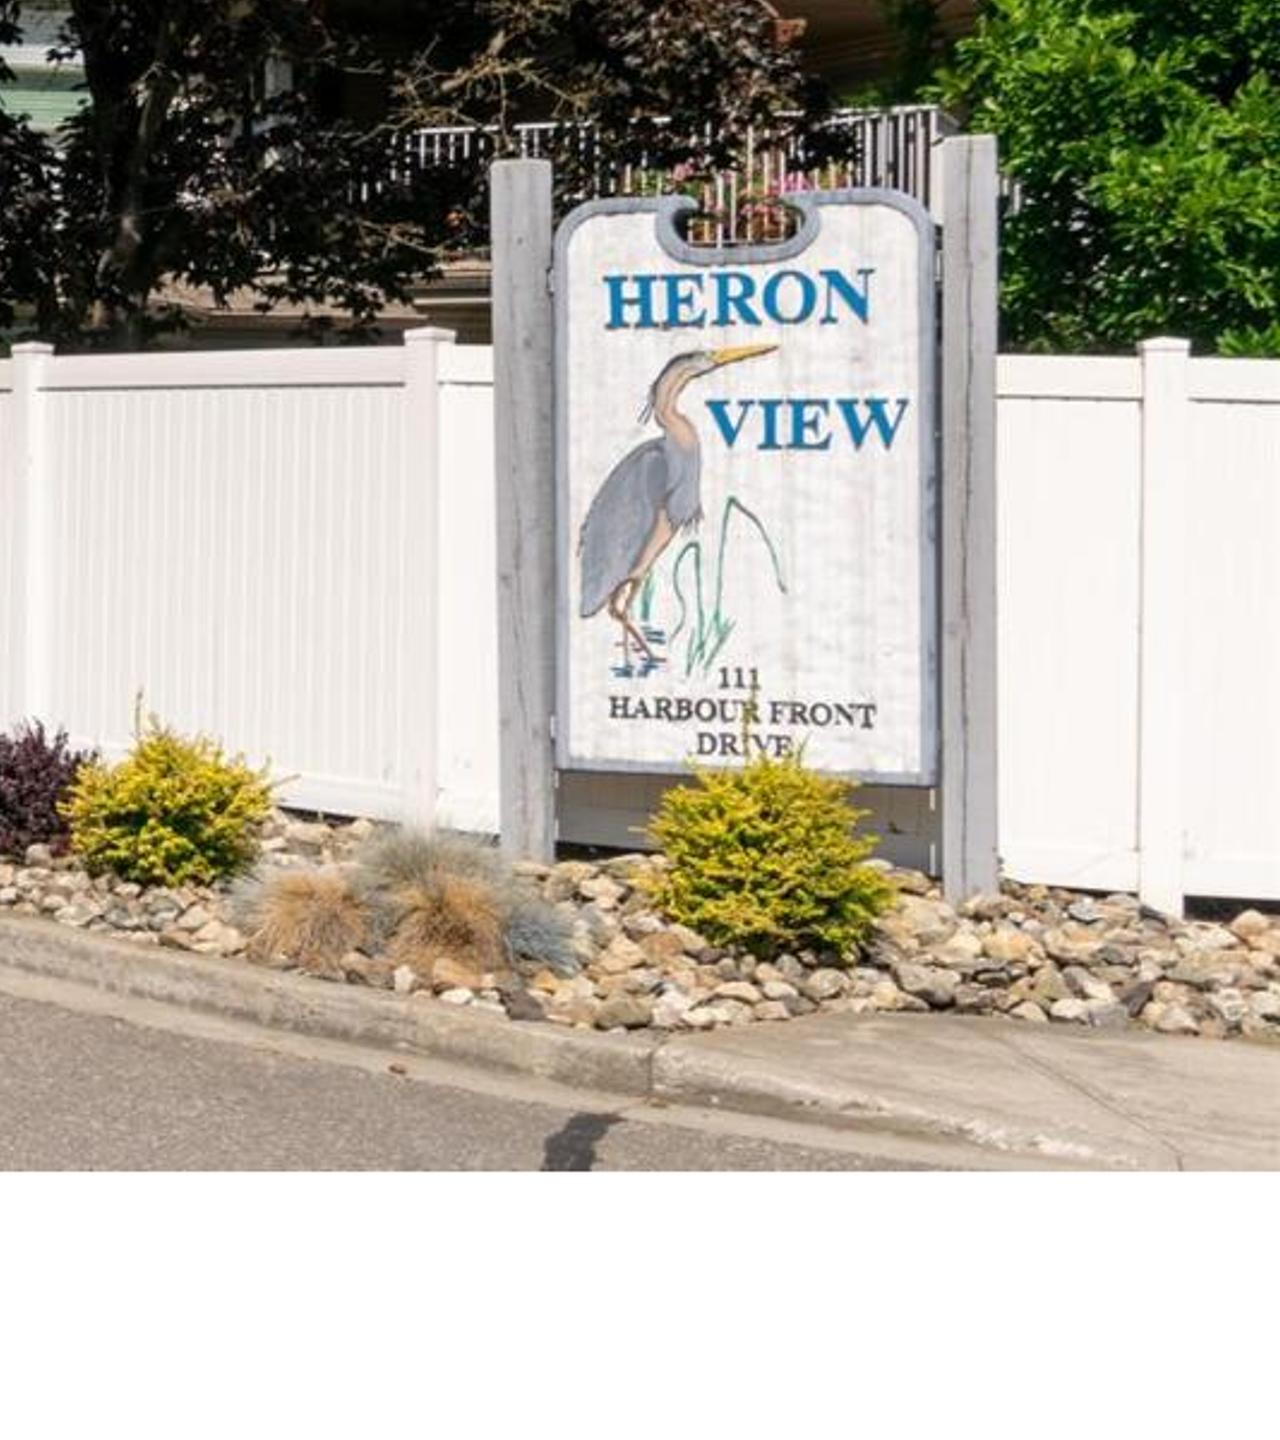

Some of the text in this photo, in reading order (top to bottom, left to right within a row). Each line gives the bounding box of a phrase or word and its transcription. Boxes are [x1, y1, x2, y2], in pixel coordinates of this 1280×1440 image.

[602, 268, 876, 330] HERON
[704, 398, 910, 450] VIEW
[718, 666, 761, 690] 111
[608, 694, 877, 729] HARBOUR FRONT
[696, 731, 794, 757] DRVE
